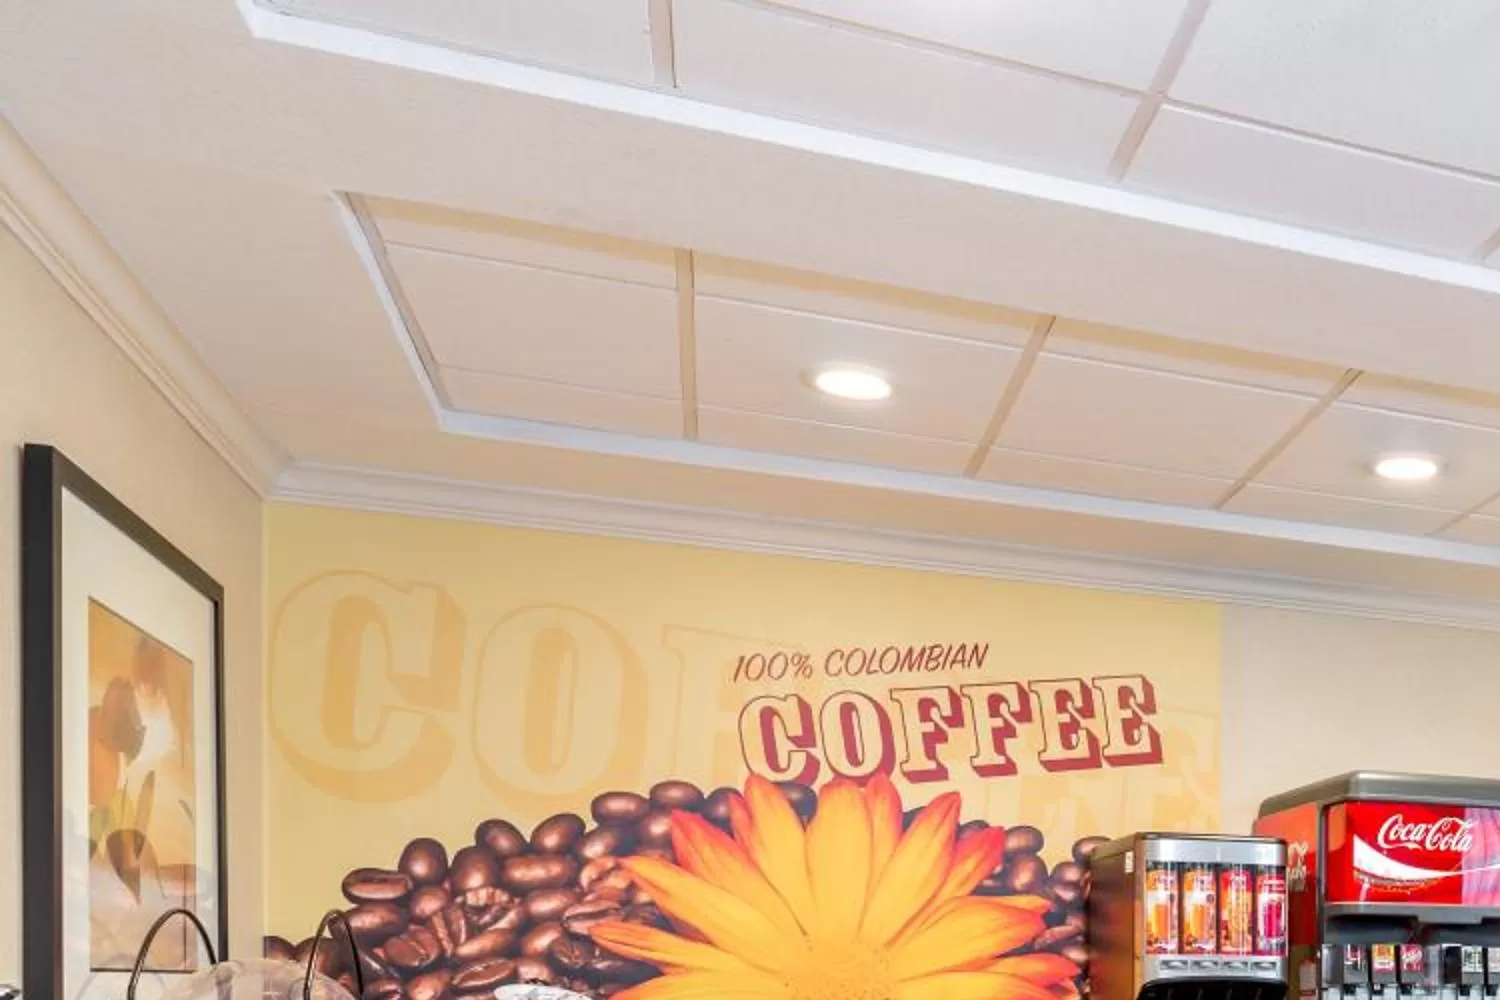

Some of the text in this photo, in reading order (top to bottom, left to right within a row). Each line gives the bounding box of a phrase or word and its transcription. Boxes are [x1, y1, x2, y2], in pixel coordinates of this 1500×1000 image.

[732, 643, 990, 683] 100% COLOMBIAN
[737, 674, 1164, 786] COFFEE
